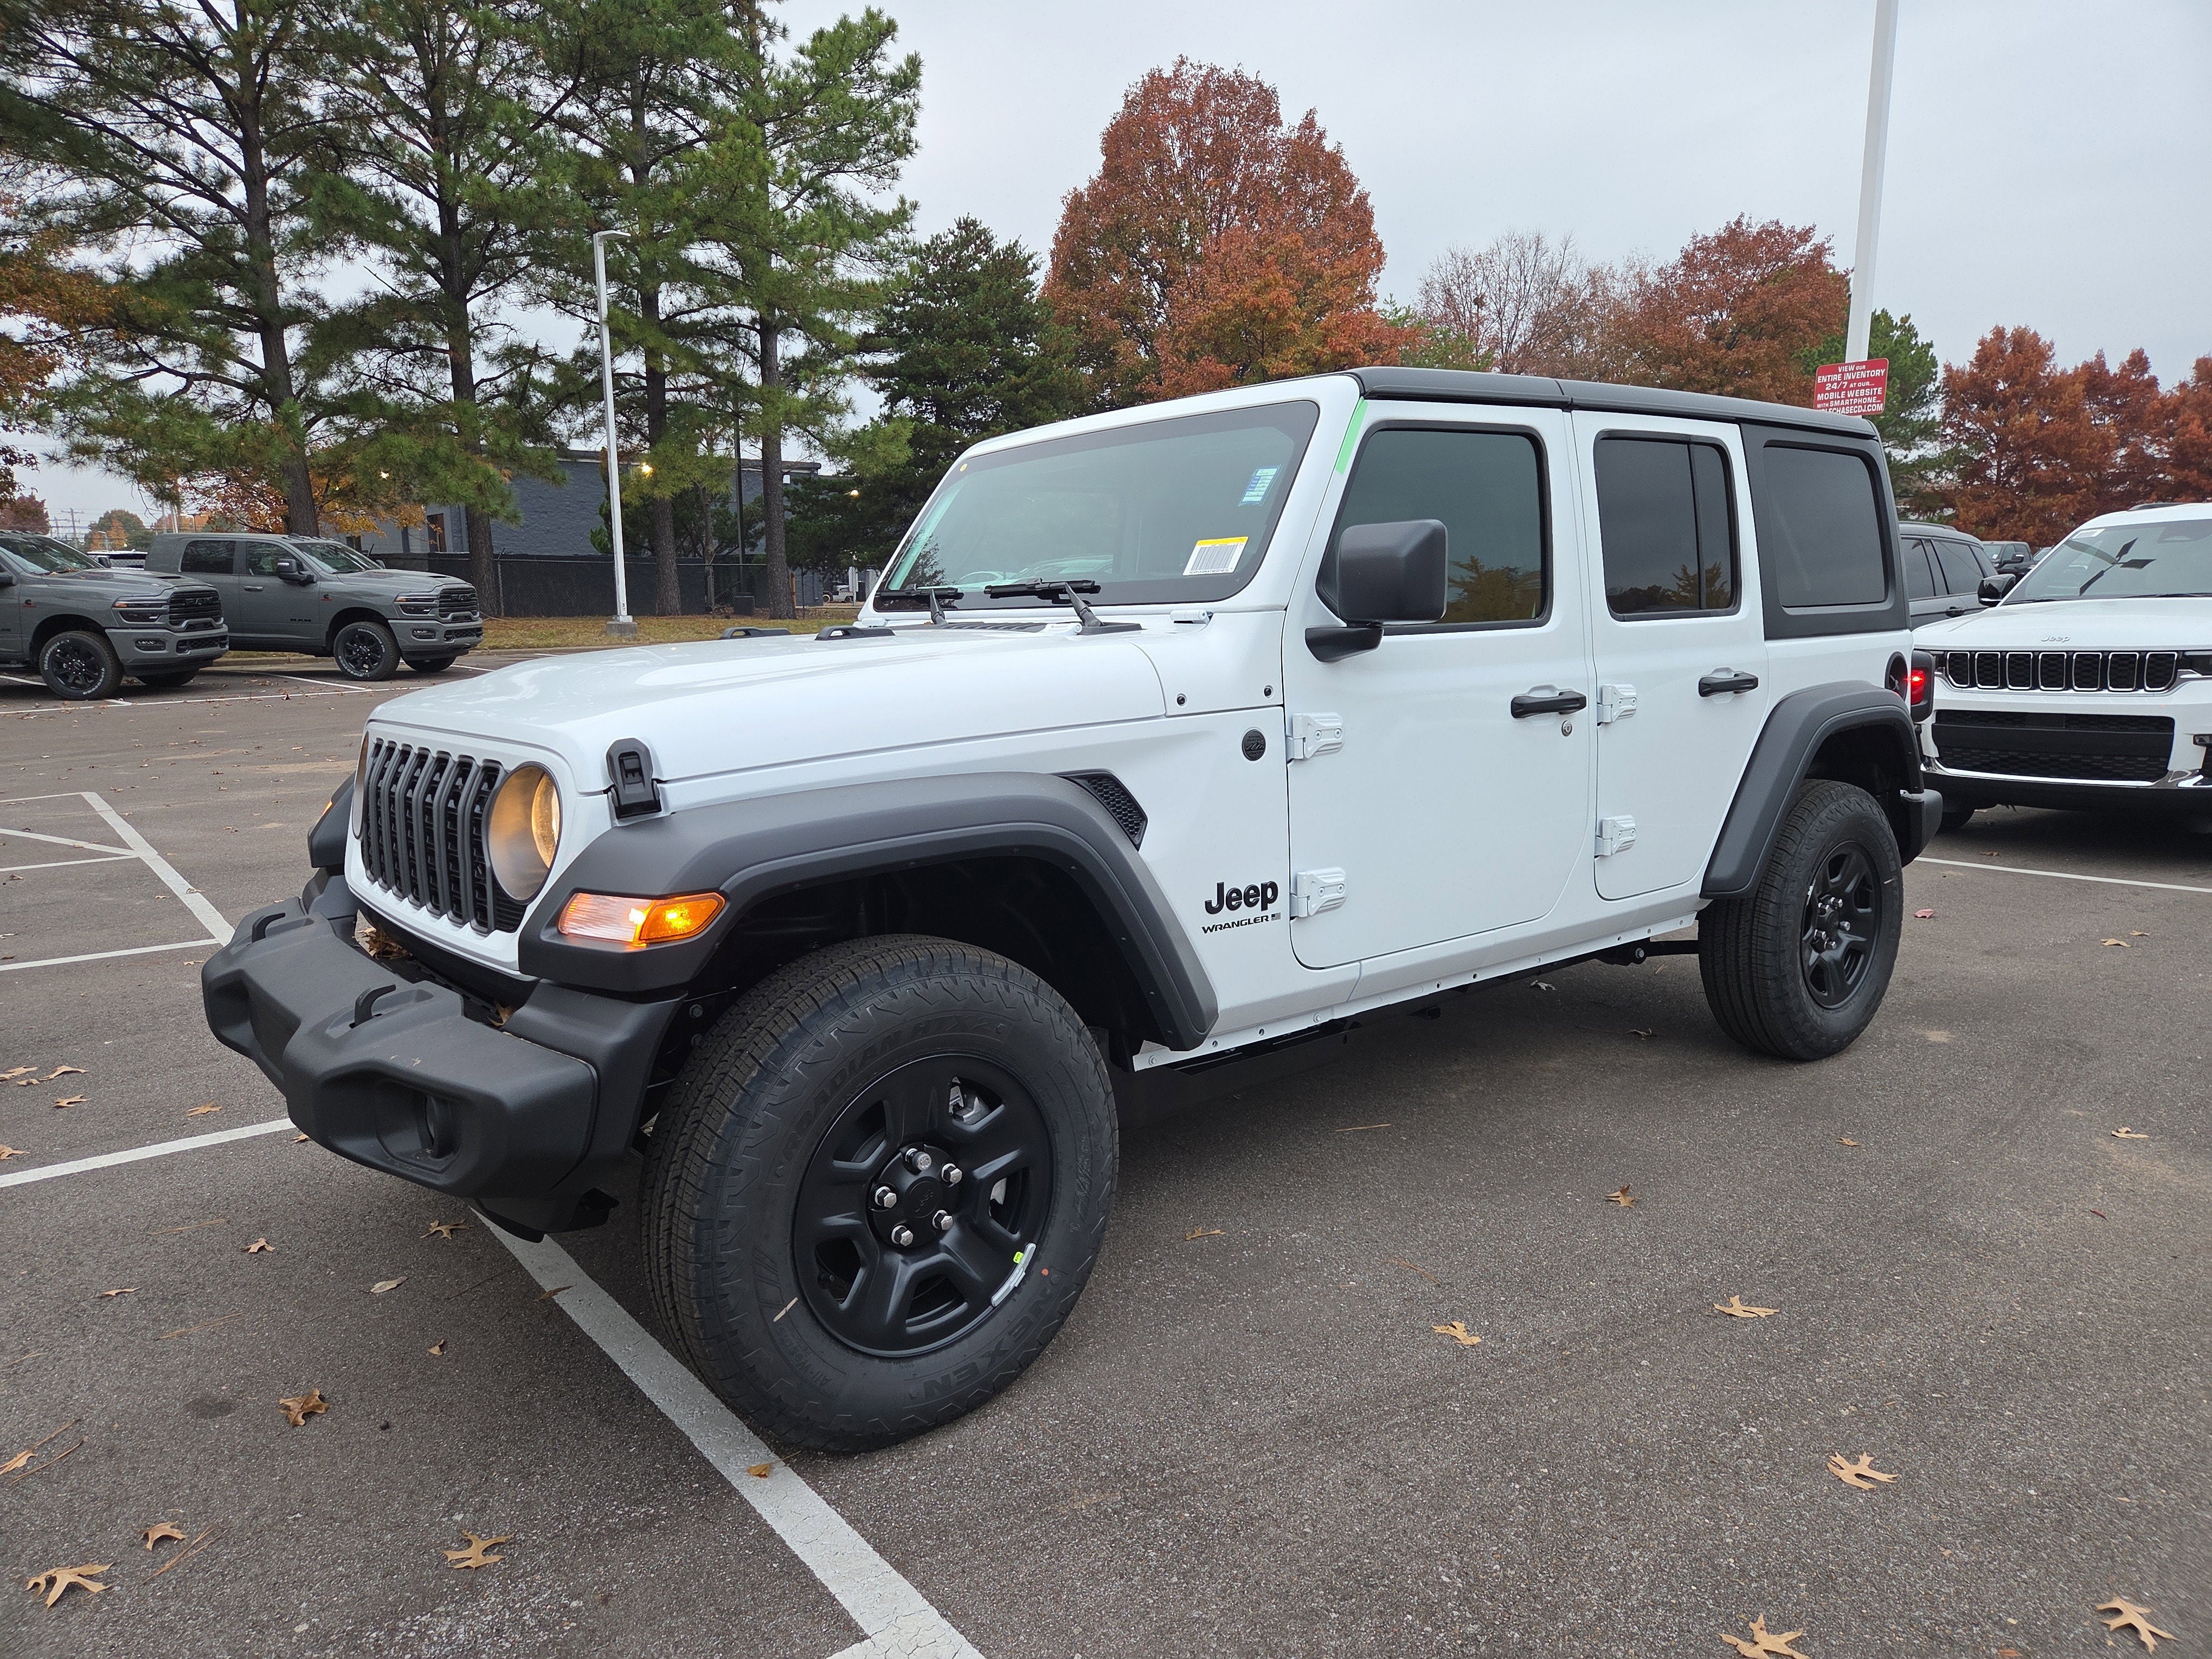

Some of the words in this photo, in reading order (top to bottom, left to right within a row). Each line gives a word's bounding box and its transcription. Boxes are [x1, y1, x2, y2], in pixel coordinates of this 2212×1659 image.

[1817, 374, 1842, 383] ENTIRE
[1843, 369, 1886, 381] INVENTORY
[1825, 381, 1848, 390] 24/7
[1817, 391, 1846, 401] MOBILE
[1847, 387, 1882, 397] WEBSITE
[1818, 403, 1883, 415] ECHASECDJ.COM
[2041, 634, 2071, 643] Jeep
[1204, 880, 1279, 915] Jeep
[1201, 915, 1270, 934] WRANGLER
